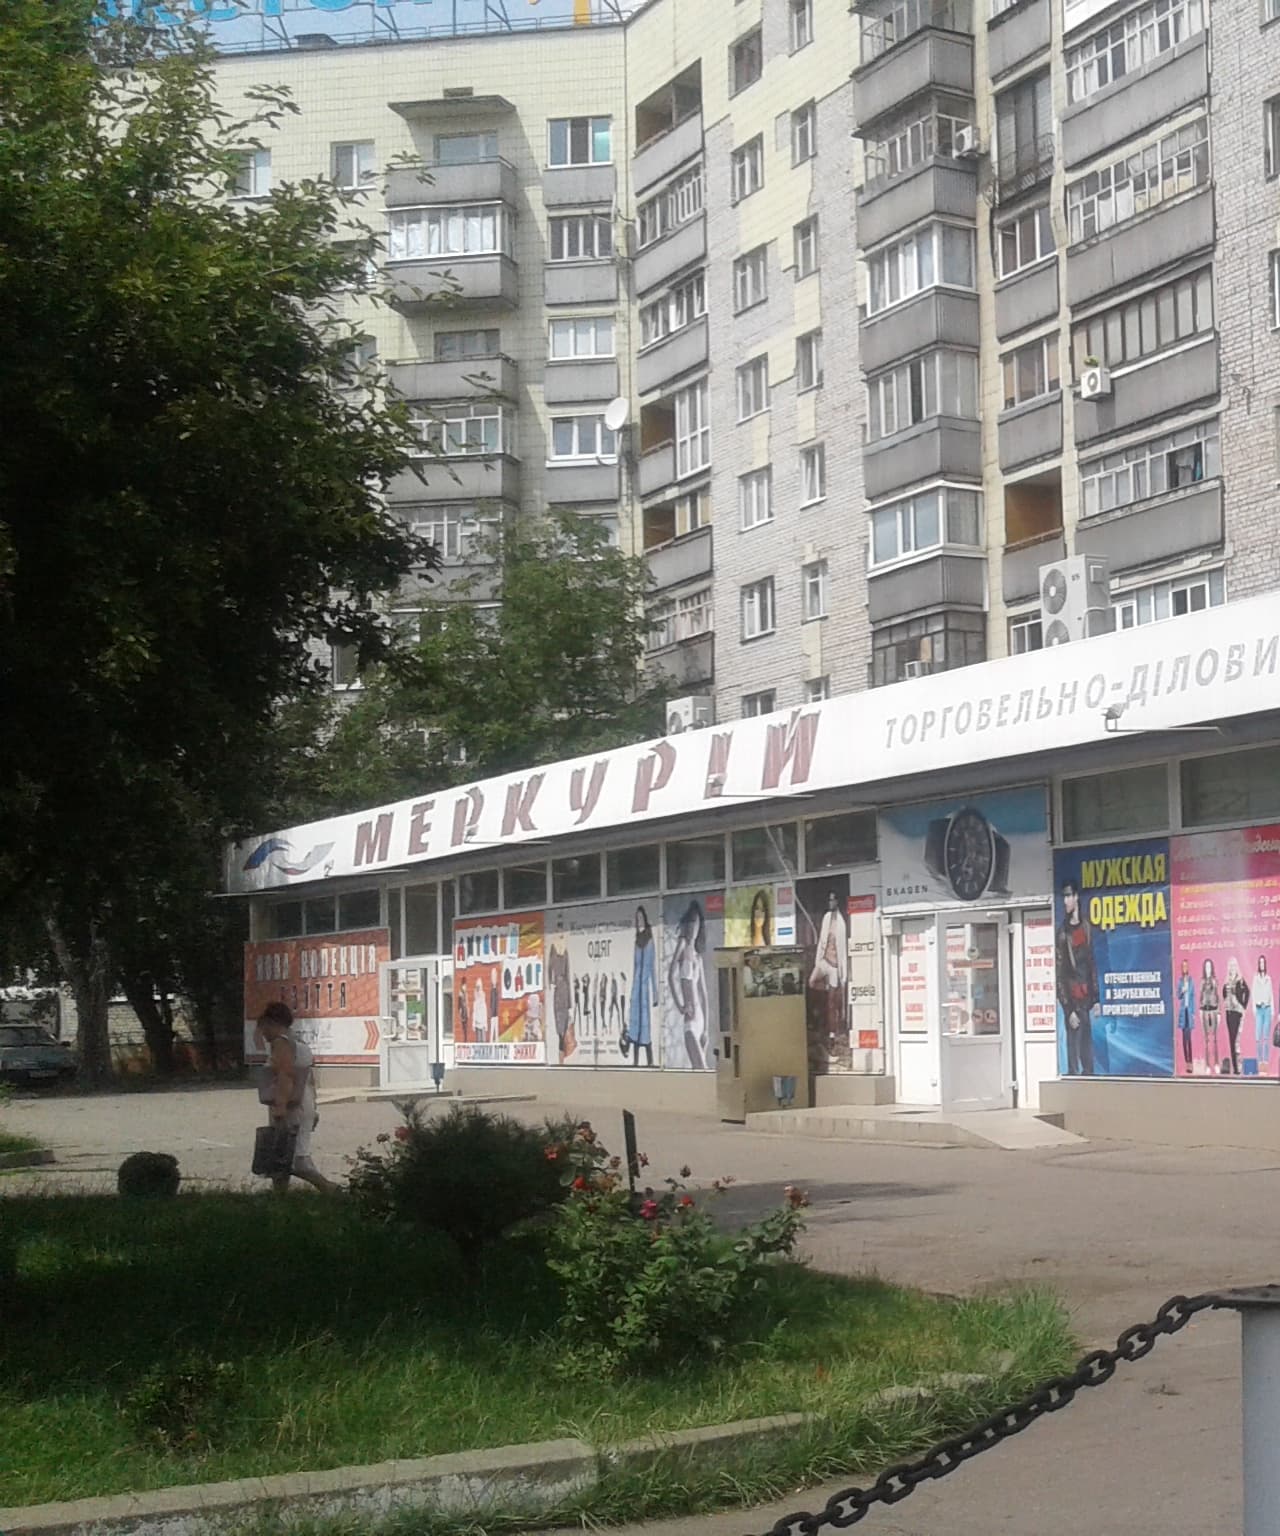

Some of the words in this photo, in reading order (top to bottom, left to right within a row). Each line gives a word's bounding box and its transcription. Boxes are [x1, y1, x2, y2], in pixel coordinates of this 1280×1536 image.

[353, 707, 822, 867] МЕРКУРІЙ
[1081, 853, 1166, 889] МУЖСКАЯ
[886, 884, 928, 897] SKAGEN
[1089, 891, 1168, 931] ОДЕЖДА
[300, 943, 377, 980] КОЛЕКЦІЯ
[587, 939, 613, 959] ОДЯГ
